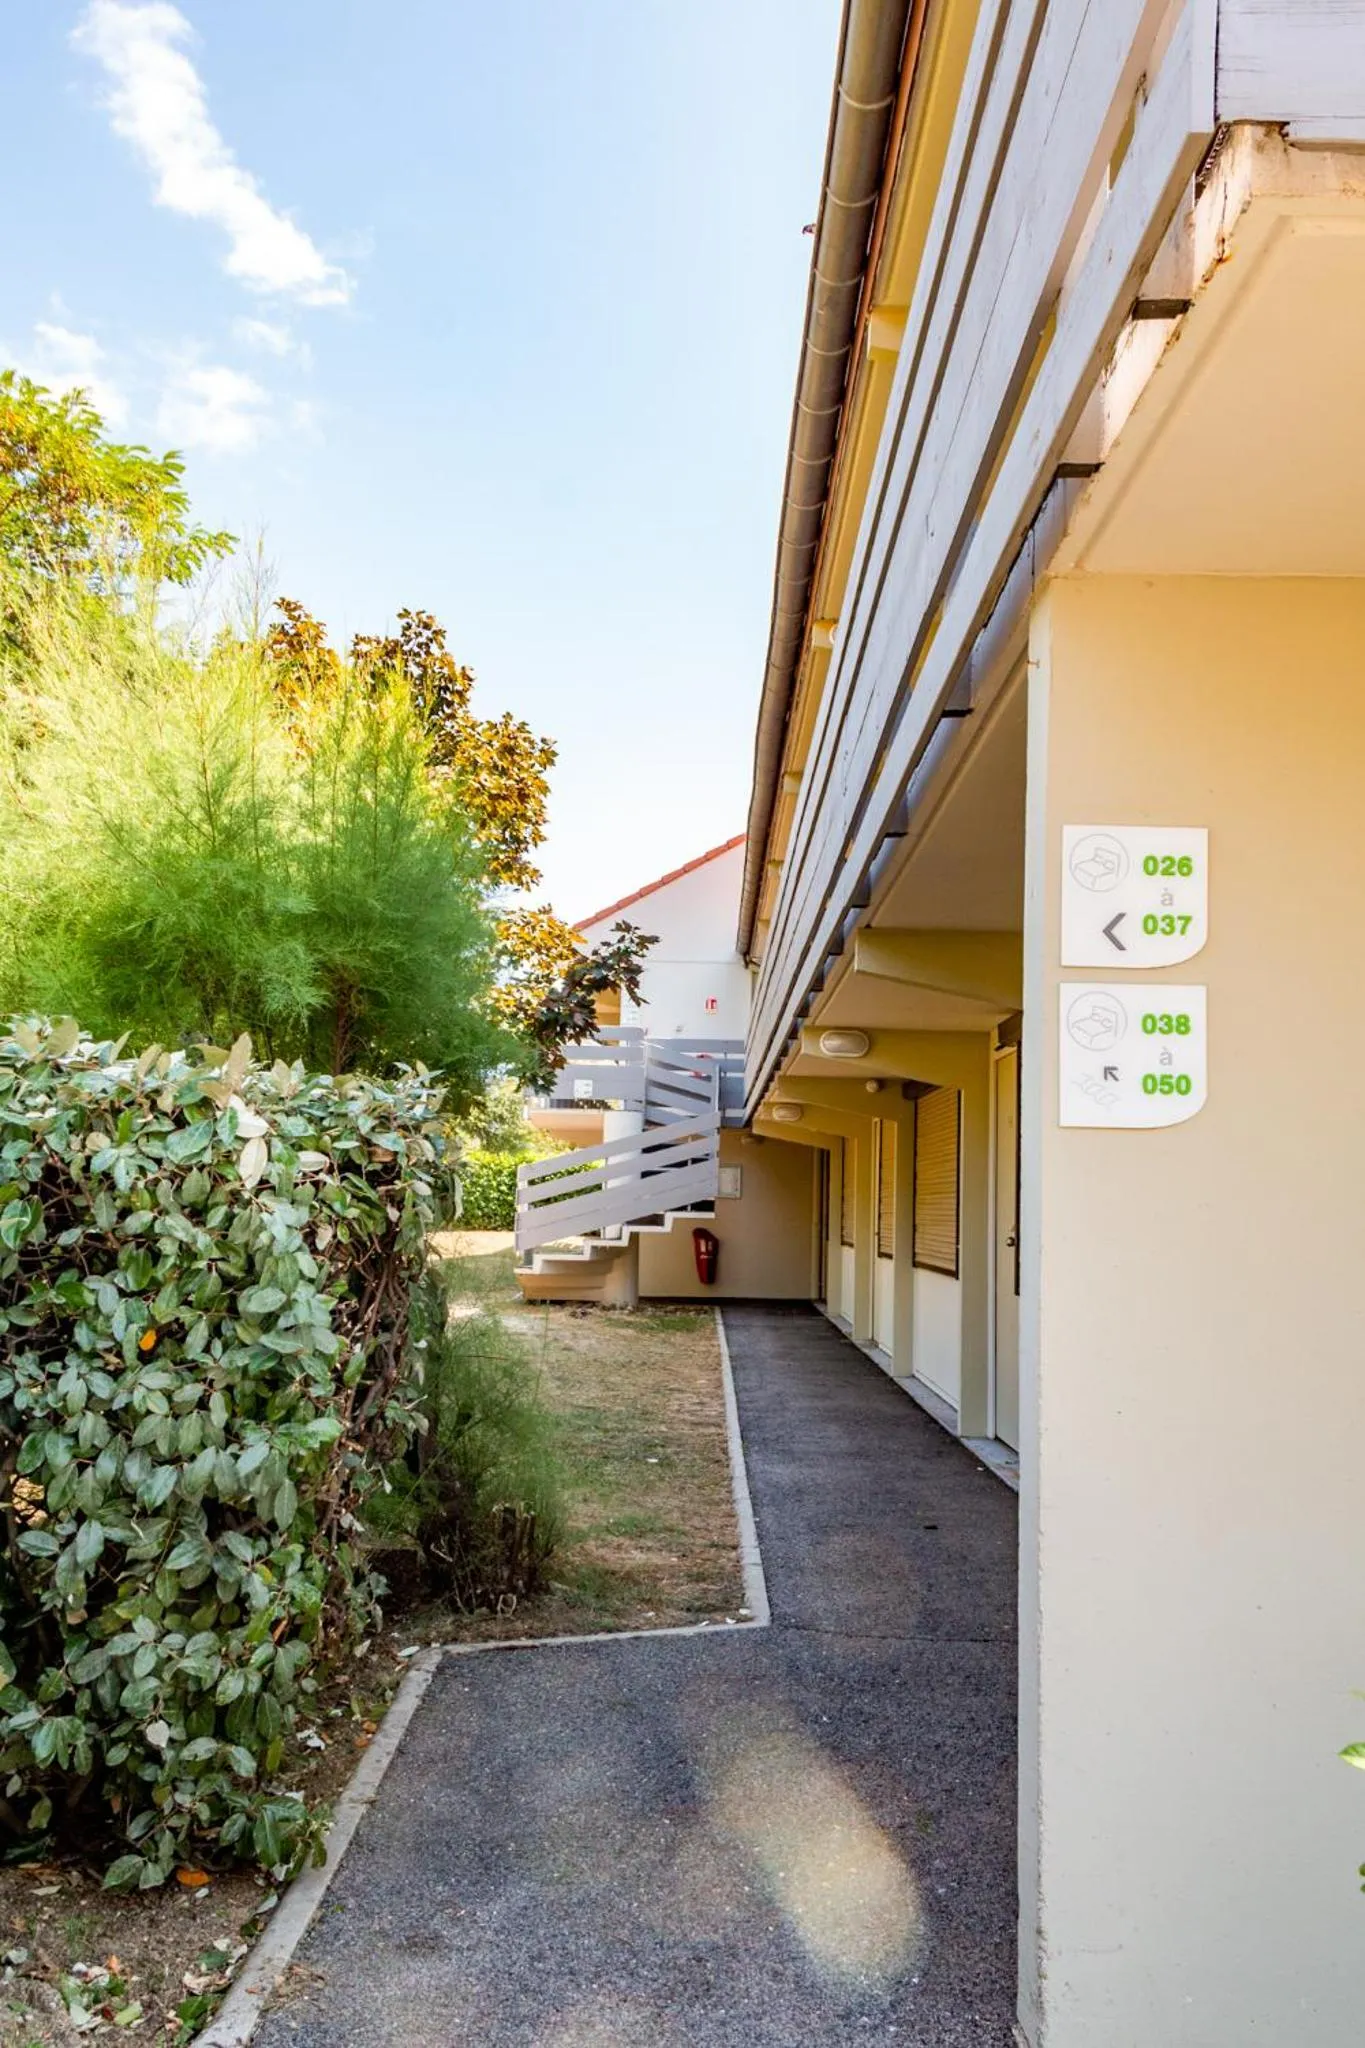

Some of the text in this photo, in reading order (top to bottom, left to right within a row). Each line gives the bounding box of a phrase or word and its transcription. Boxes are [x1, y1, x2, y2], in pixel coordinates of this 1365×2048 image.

[1143, 855, 1193, 877] 026
[1160, 887, 1173, 907] à
[1143, 913, 1193, 936] 037
[1142, 1013, 1191, 1035] 038
[1159, 1046, 1173, 1066] à
[1142, 1073, 1191, 1096] 050
